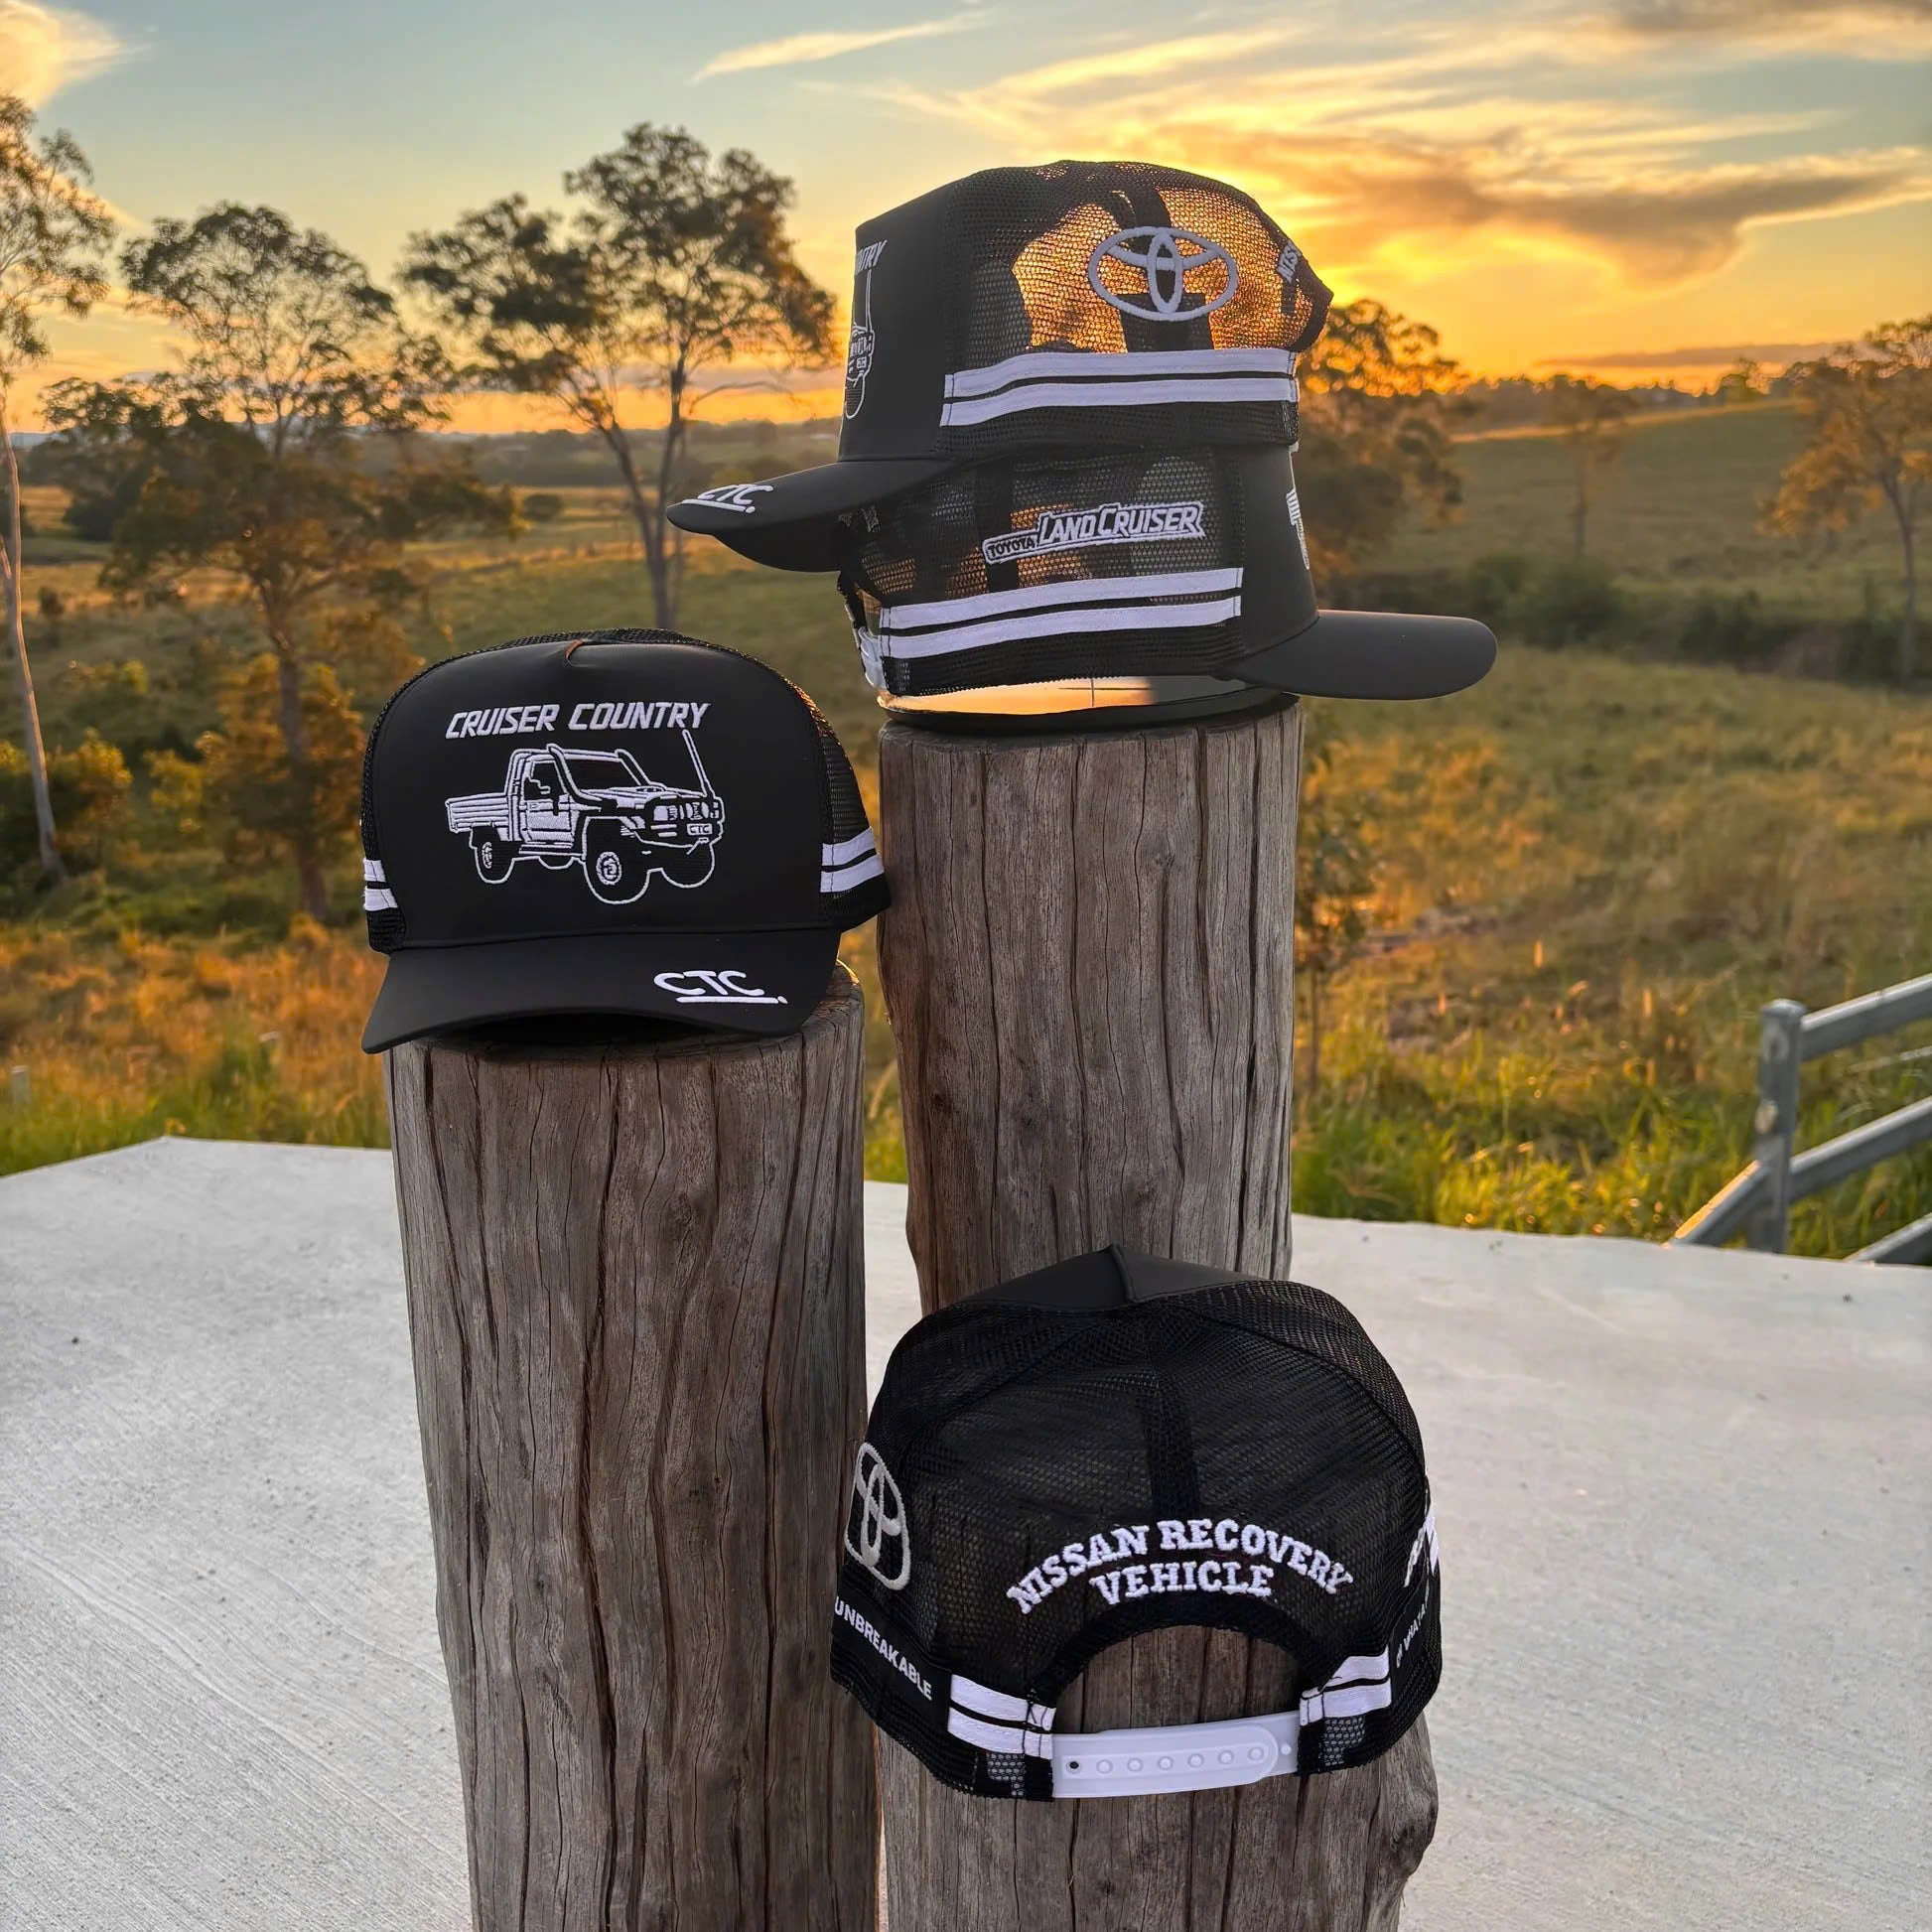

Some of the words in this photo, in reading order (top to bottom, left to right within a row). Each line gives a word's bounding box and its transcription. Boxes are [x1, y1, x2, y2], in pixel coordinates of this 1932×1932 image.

[856, 239, 888, 275] NTRY
[987, 536, 1035, 558] TOYOTA
[445, 703, 561, 739] CRUISER
[568, 701, 712, 731] COUNTRY
[689, 825, 711, 835] CTC
[1007, 1525, 1150, 1615] NISSAN
[1157, 1518, 1354, 1595] RECOVERY
[1089, 1560, 1275, 1605] VEHICLE
[834, 1595, 933, 1702] UNBREAKABLE
